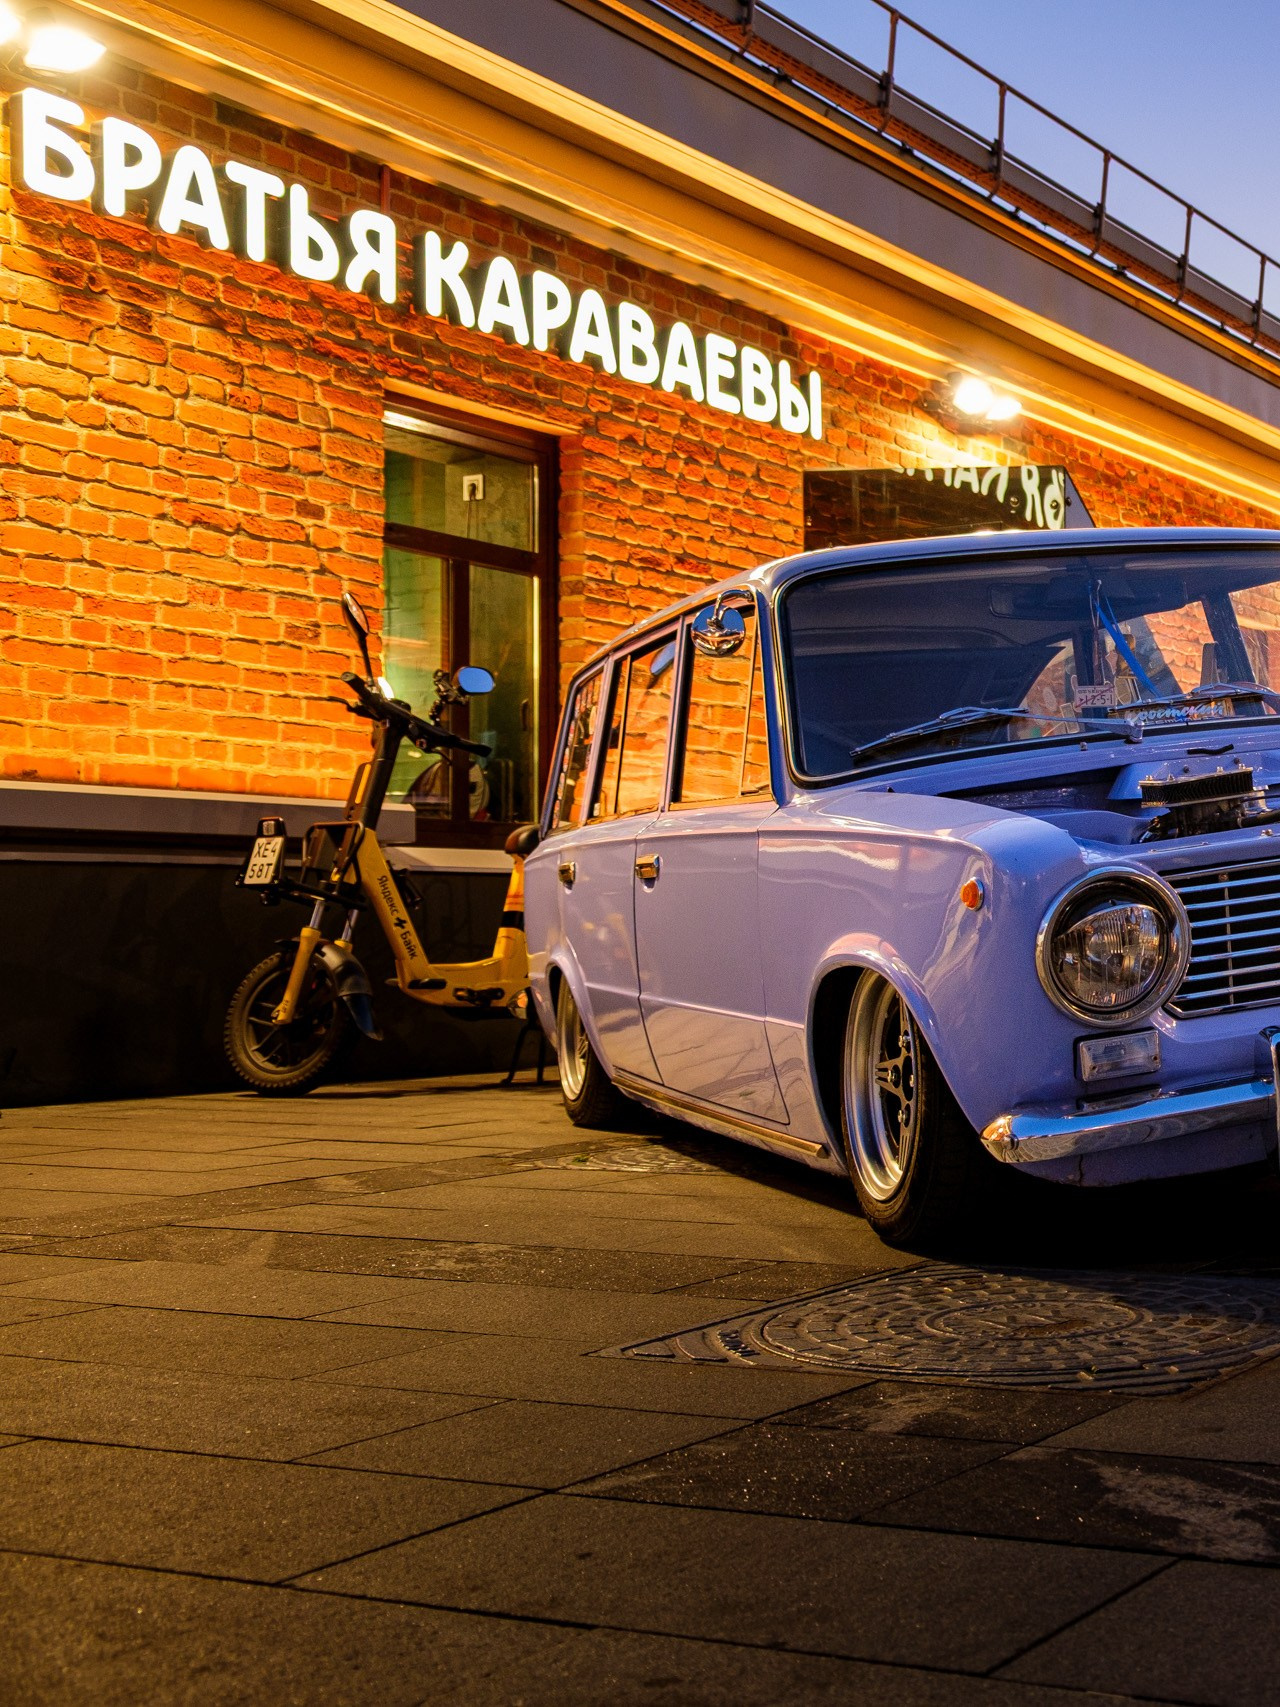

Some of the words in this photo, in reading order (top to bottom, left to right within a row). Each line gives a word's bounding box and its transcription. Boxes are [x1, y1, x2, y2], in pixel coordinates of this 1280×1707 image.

[21, 86, 397, 304] БРАТЬЯ
[424, 231, 823, 440] КАРАВАЕВЫ
[377, 875, 399, 917] Яндекс
[400, 930, 418, 960] Байк
